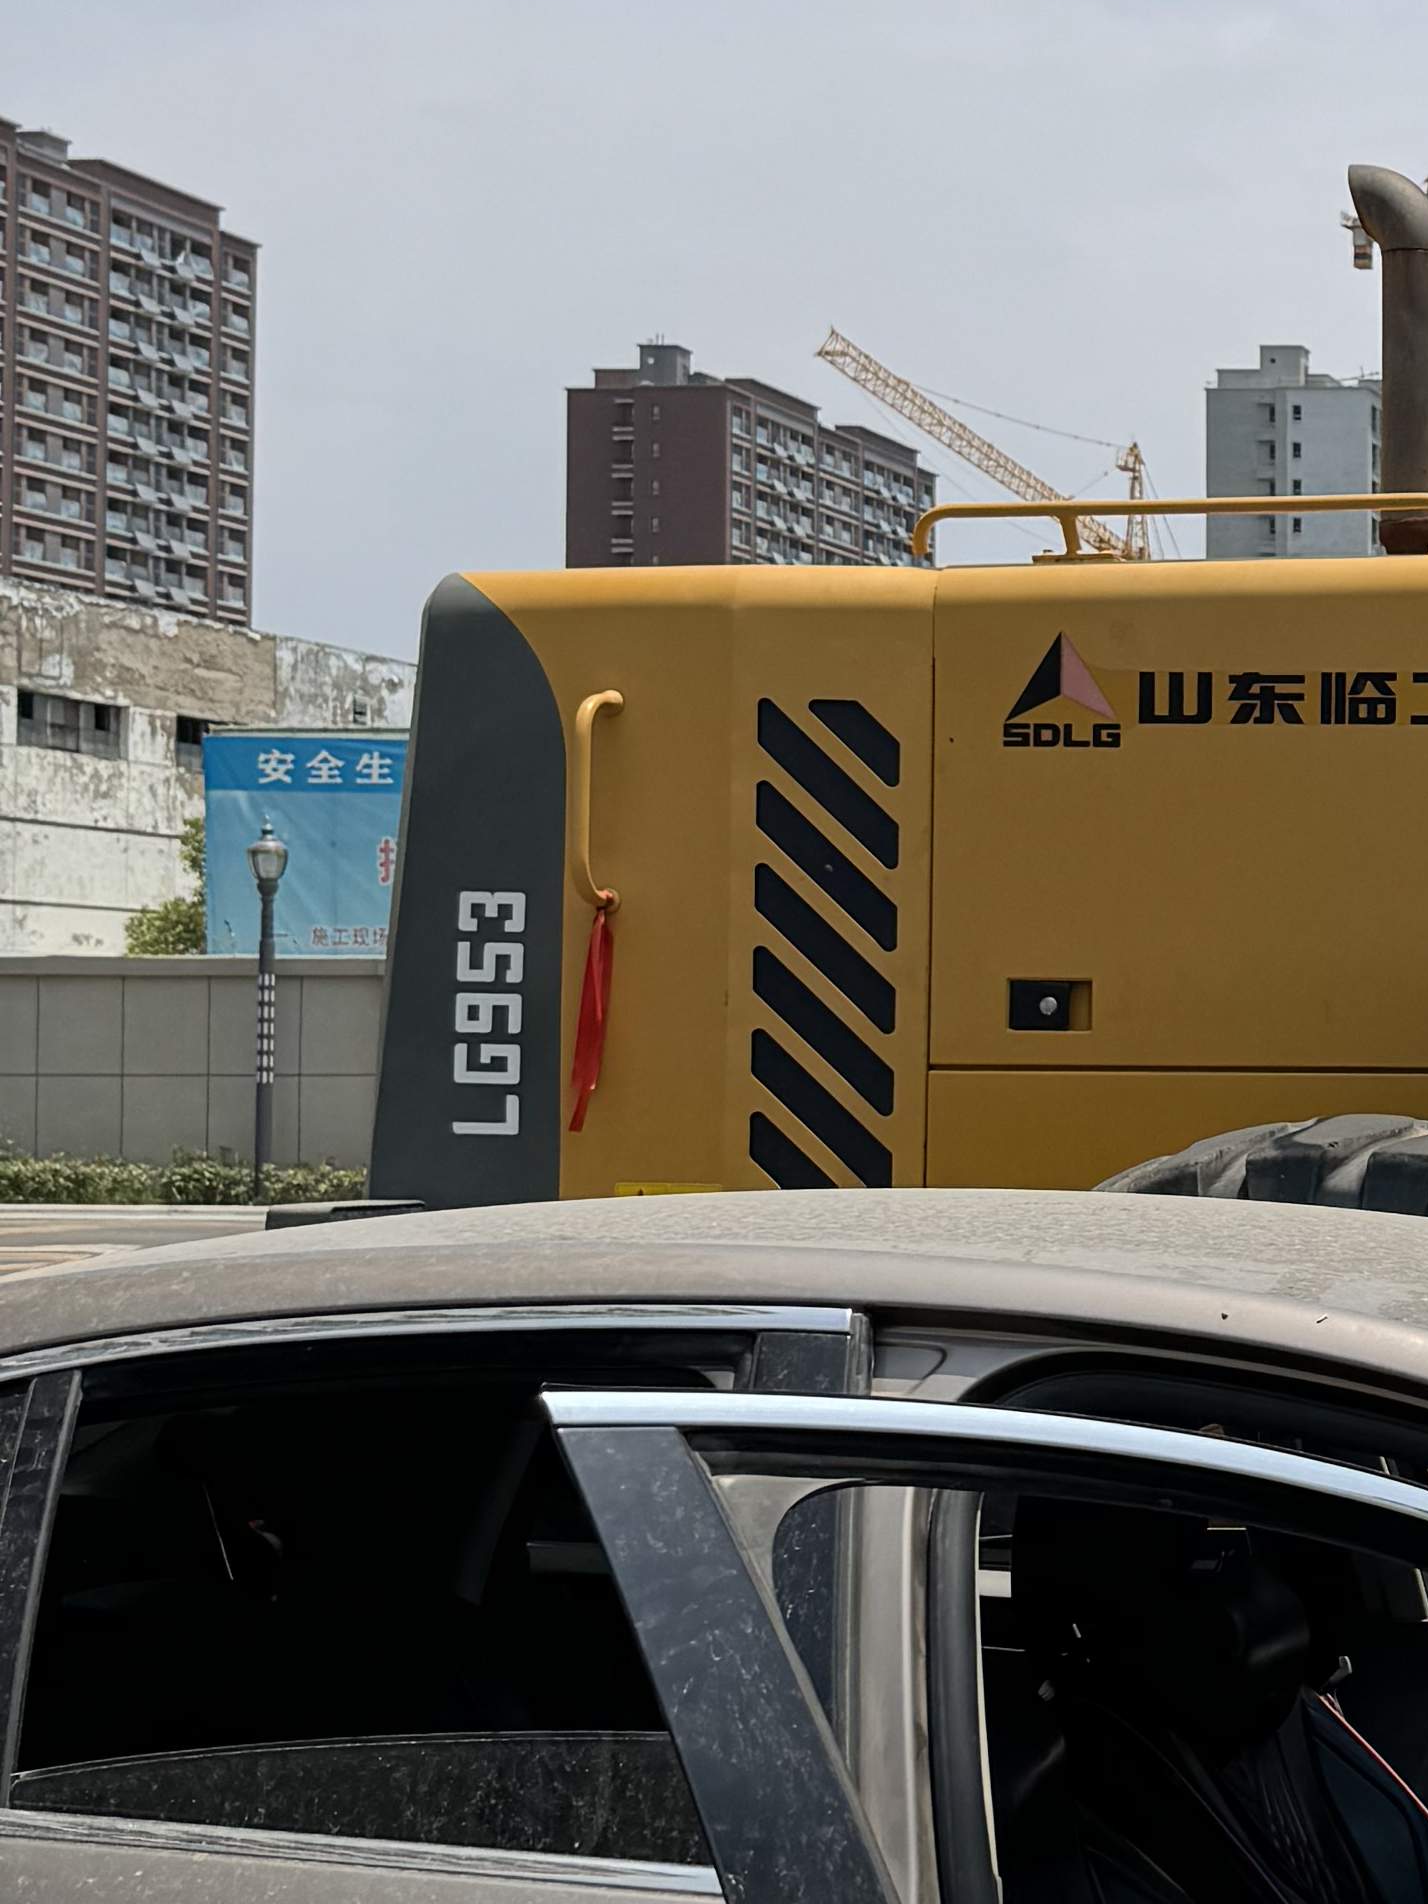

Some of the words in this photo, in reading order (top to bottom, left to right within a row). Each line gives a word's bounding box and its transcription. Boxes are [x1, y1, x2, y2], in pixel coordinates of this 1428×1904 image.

[1002, 722, 1121, 748] SDLG
[256, 748, 395, 785] 安全生
[311, 926, 388, 948] 施工现场
[452, 889, 527, 1136] LG953
